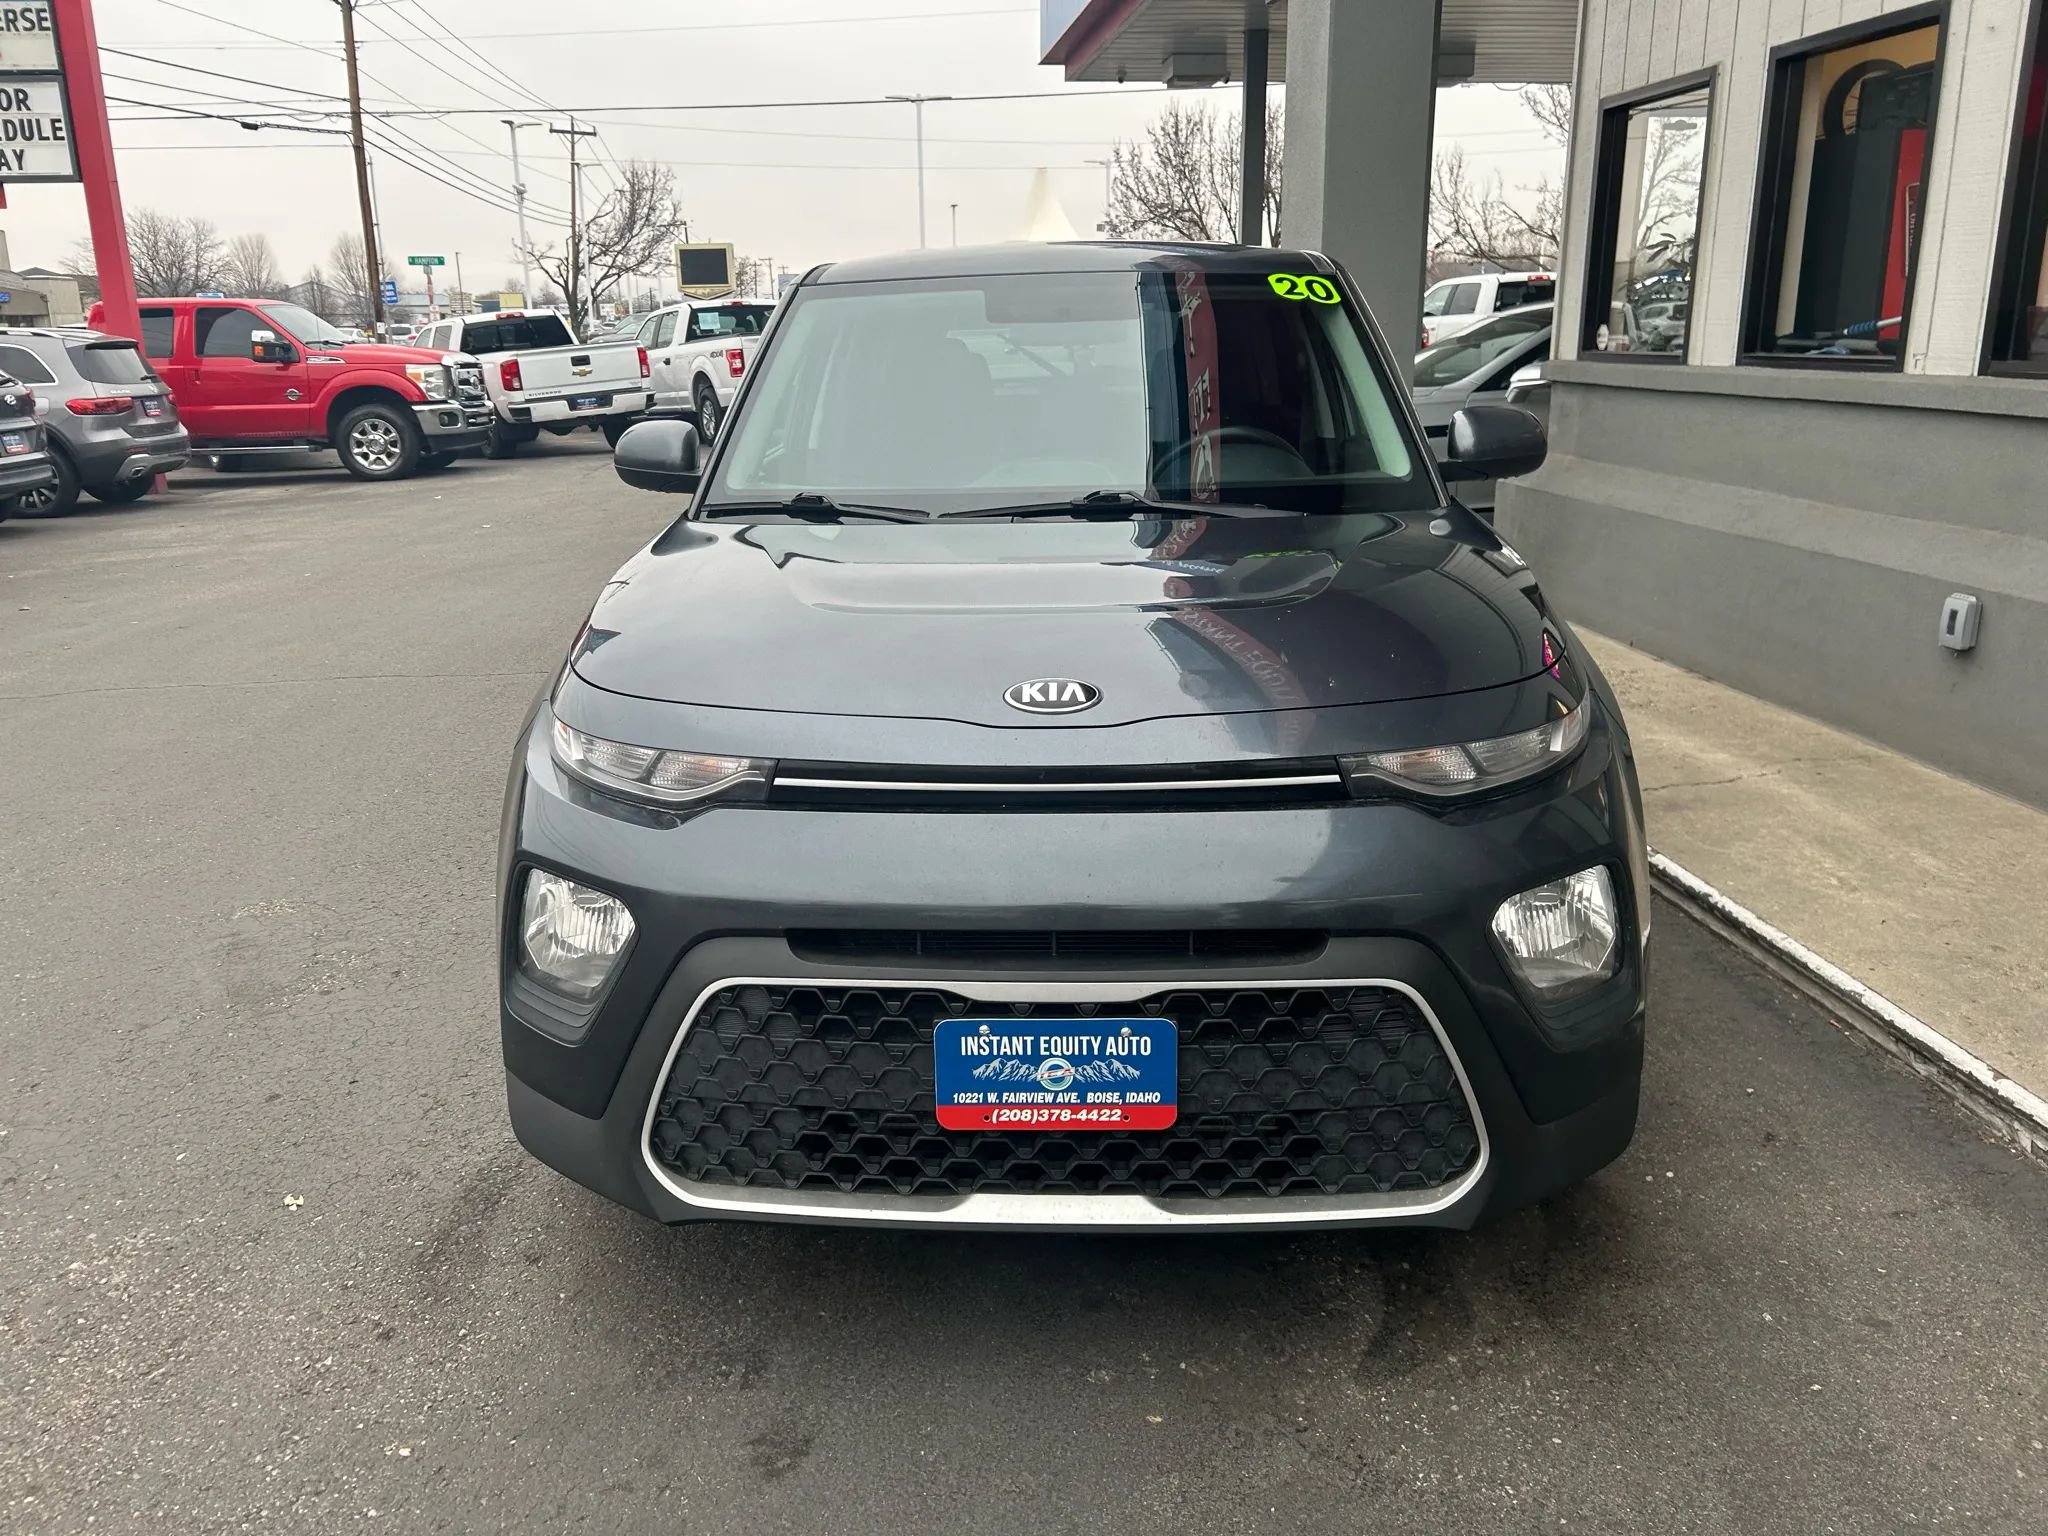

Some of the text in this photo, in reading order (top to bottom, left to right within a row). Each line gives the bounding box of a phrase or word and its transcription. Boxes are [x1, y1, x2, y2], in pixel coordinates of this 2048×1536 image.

[0, 8, 51, 32] RSE
[0, 118, 66, 142] DULE
[414, 257, 439, 265] HAMPTON
[1274, 276, 1336, 301] 20
[1021, 682, 1087, 703] KIA
[961, 1036, 1151, 1056] INSTANT EQUITY AUTO
[953, 1092, 1161, 1105] 10221 W. FAIRVIEW AVE. BOISE, IDAHO
[991, 1109, 1122, 1124] (208)378-4422
